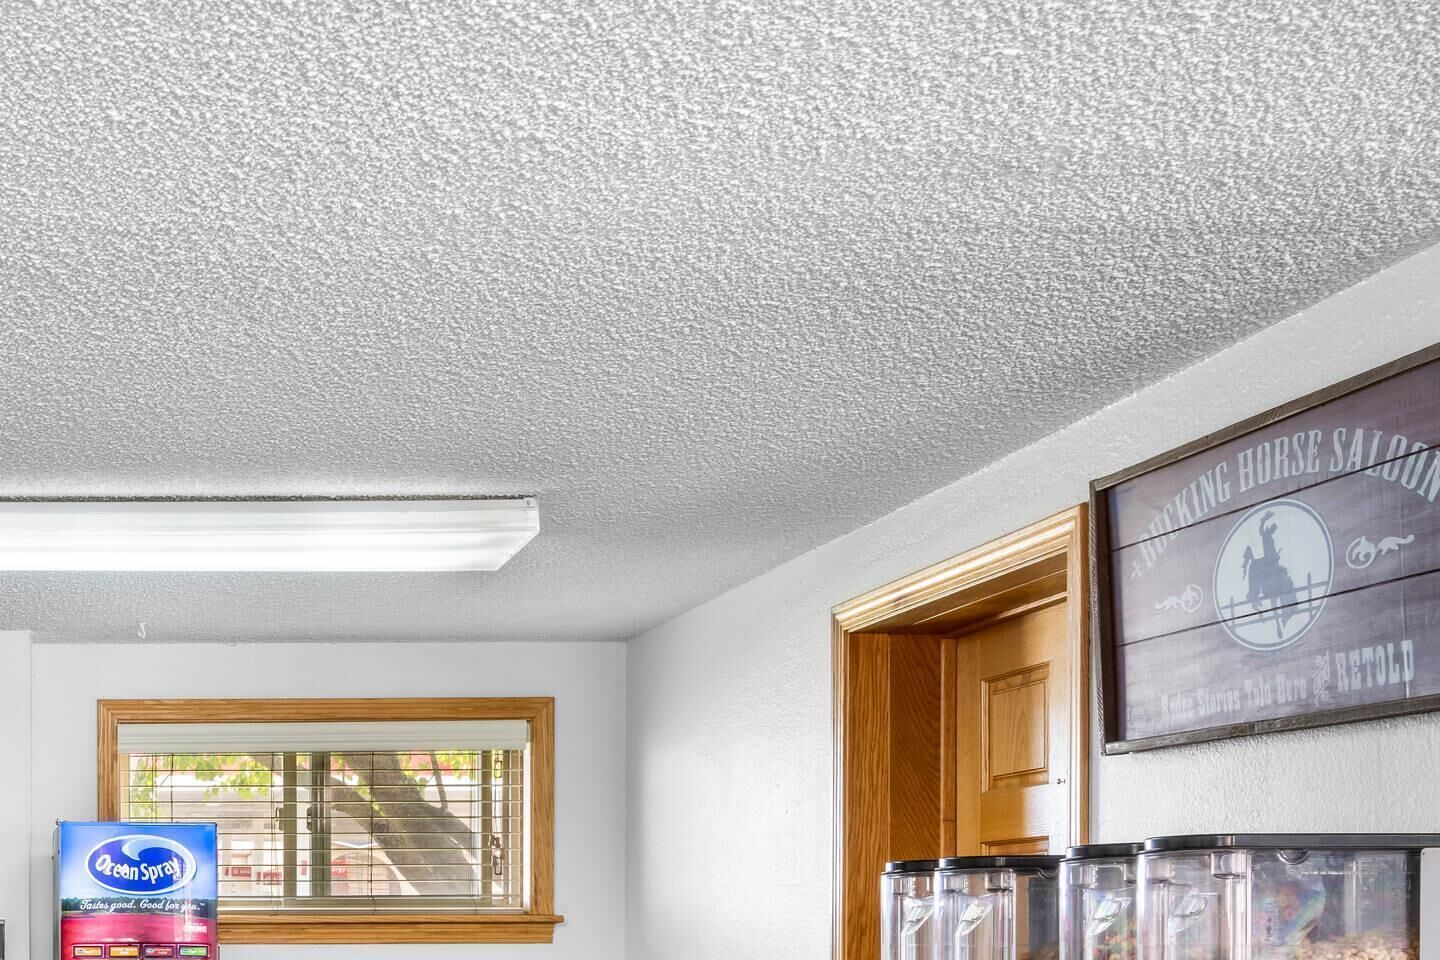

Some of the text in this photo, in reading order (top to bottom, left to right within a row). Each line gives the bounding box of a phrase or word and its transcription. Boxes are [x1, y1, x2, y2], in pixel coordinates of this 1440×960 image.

[1139, 461, 1231, 568] BUCKING
[1237, 429, 1322, 493] HORSE
[1336, 640, 1415, 692] RETOLD
[95, 854, 181, 884] Ocean Spray
[80, 899, 109, 910] Tastes
[110, 899, 137, 913] good.
[139, 899, 164, 910] Good
[165, 900, 180, 912] for
